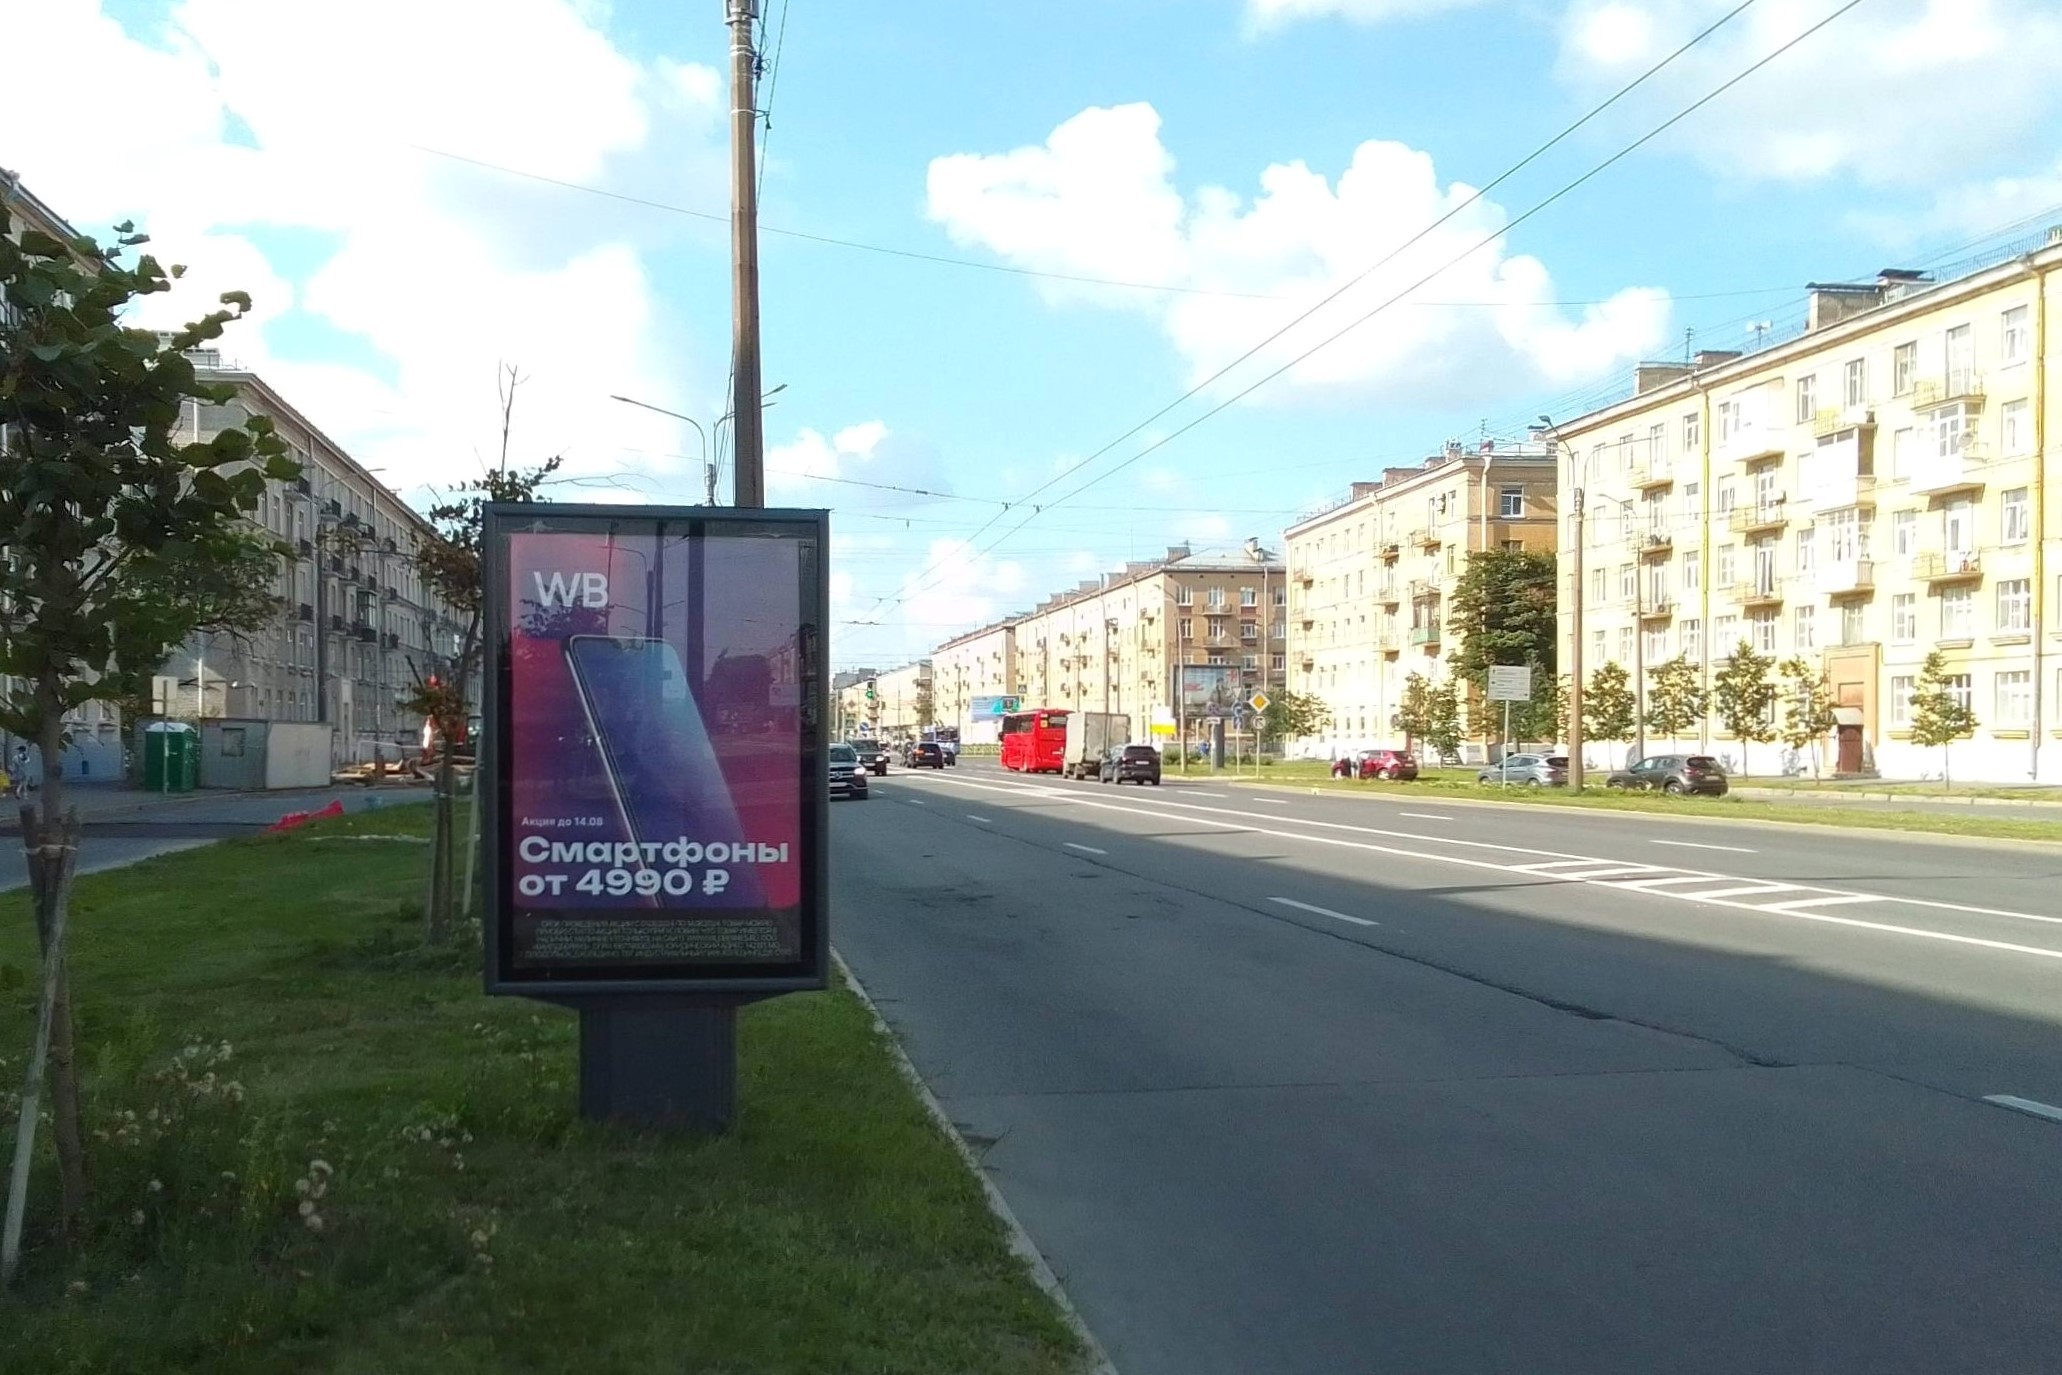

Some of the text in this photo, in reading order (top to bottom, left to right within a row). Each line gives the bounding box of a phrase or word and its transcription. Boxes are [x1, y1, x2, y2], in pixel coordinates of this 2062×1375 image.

[533, 571, 608, 608] WB
[521, 817, 555, 827] Акция
[558, 818, 572, 828] до
[519, 836, 789, 867] Смартфоны
[519, 869, 730, 896] от 4990 ₽
